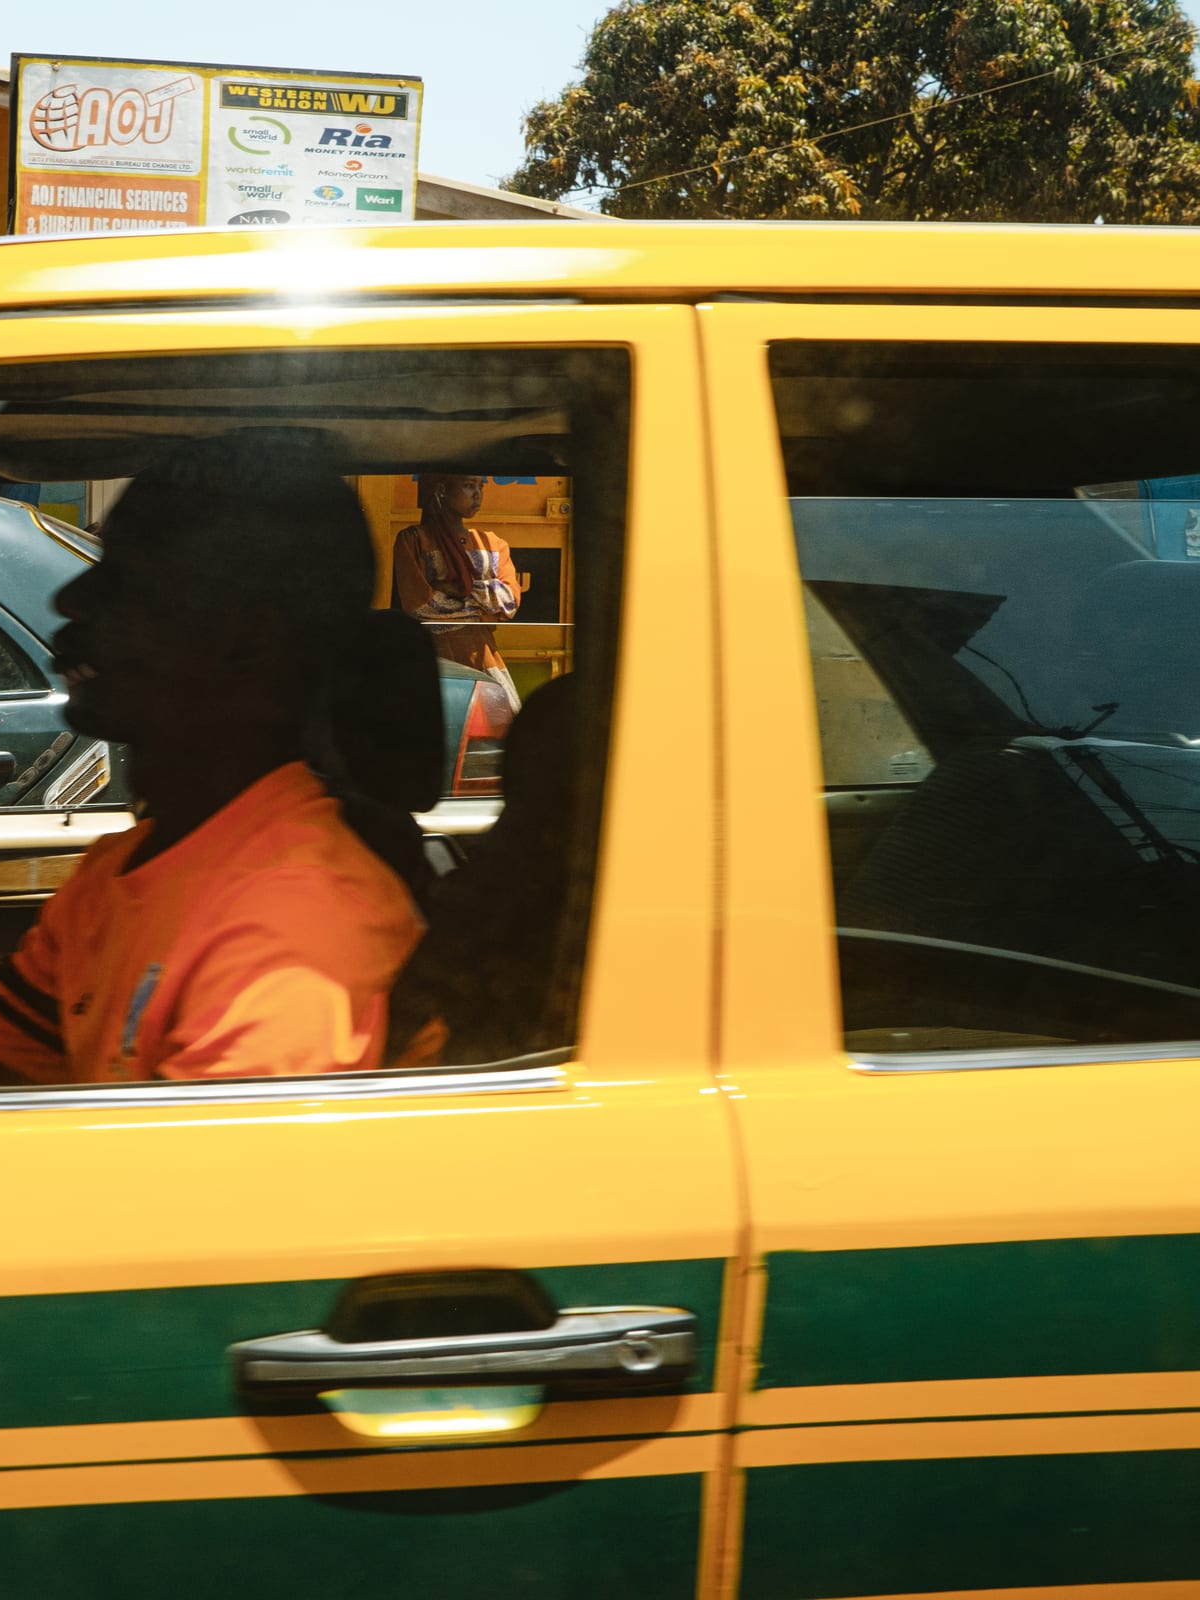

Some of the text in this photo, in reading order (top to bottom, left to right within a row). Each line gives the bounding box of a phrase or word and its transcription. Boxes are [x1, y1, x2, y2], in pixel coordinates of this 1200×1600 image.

[228, 85, 397, 114] WESTERN WU
[259, 97, 328, 111] UNION
[73, 77, 195, 146] AOJ
[250, 133, 278, 142] world
[318, 123, 392, 149] Ria
[304, 147, 406, 159] MONEY TRANSFER
[116, 160, 141, 168] BUREAU
[225, 165, 295, 177] worldremit
[318, 170, 388, 180] MoneyGram
[238, 184, 272, 193] small
[31, 184, 188, 213] AOJ FINANCIAL SERVICES
[246, 191, 282, 200] world
[364, 194, 396, 205] Wari
[27, 216, 38, 235] &
[39, 215, 91, 234] BUREAU
